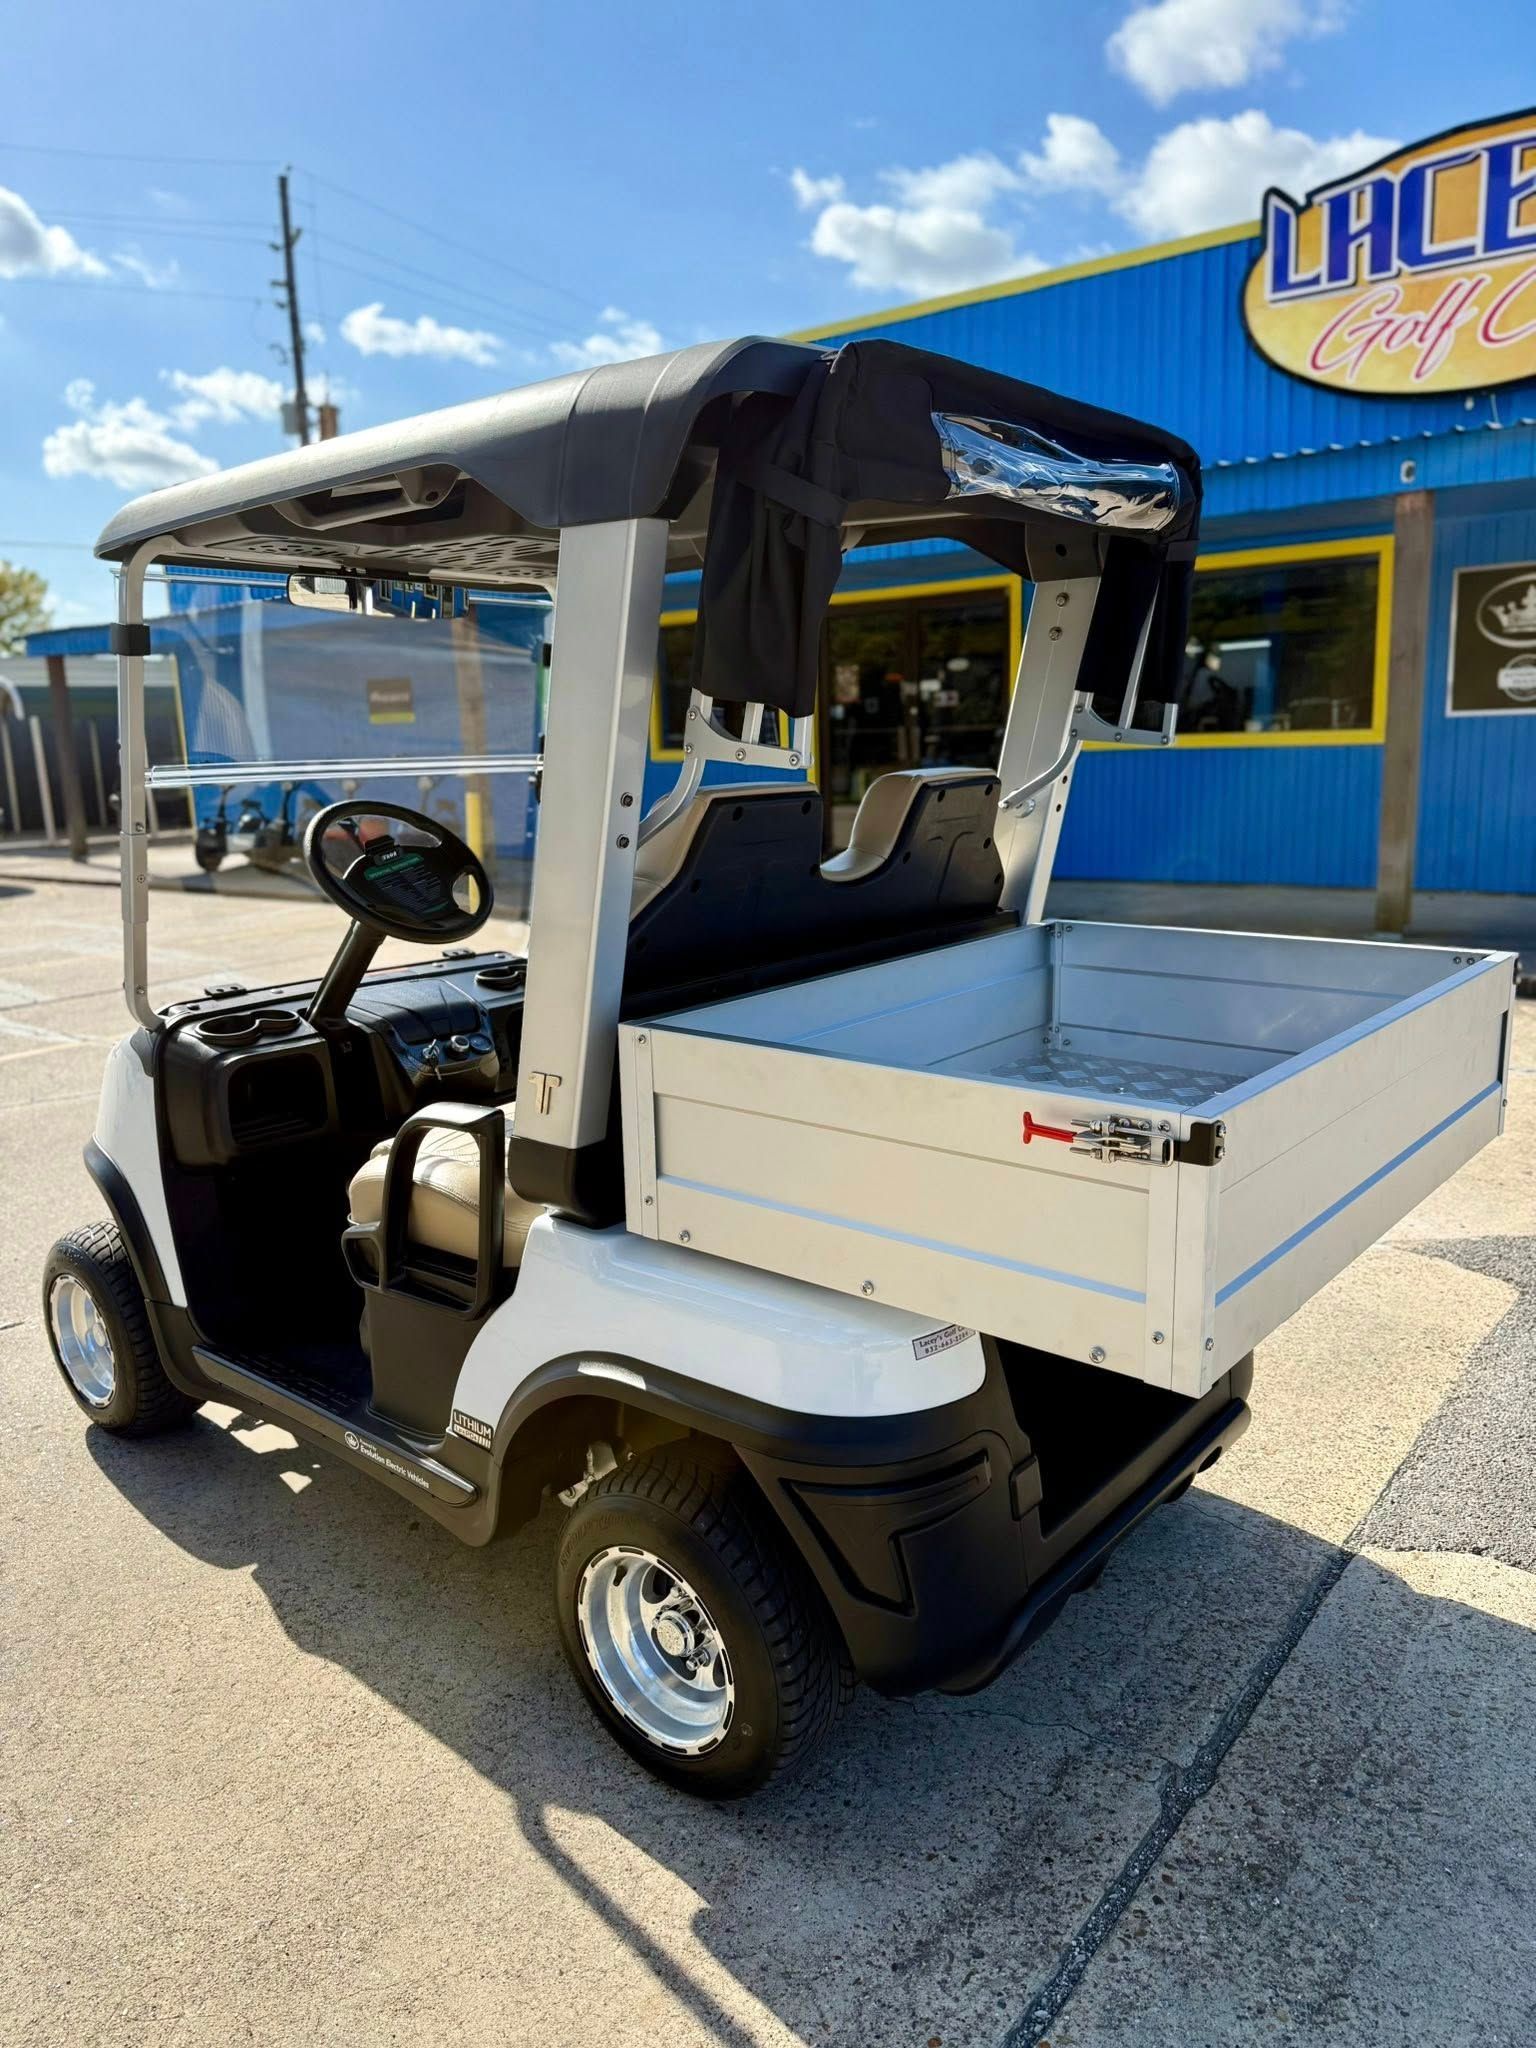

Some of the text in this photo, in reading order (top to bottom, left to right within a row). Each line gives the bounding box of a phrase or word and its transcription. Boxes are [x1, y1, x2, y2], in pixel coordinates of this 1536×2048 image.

[1309, 274, 1490, 382] Golf
[453, 1411, 492, 1439] LITHIUM
[360, 1444, 430, 1489] Evolution Electric Vehicles
